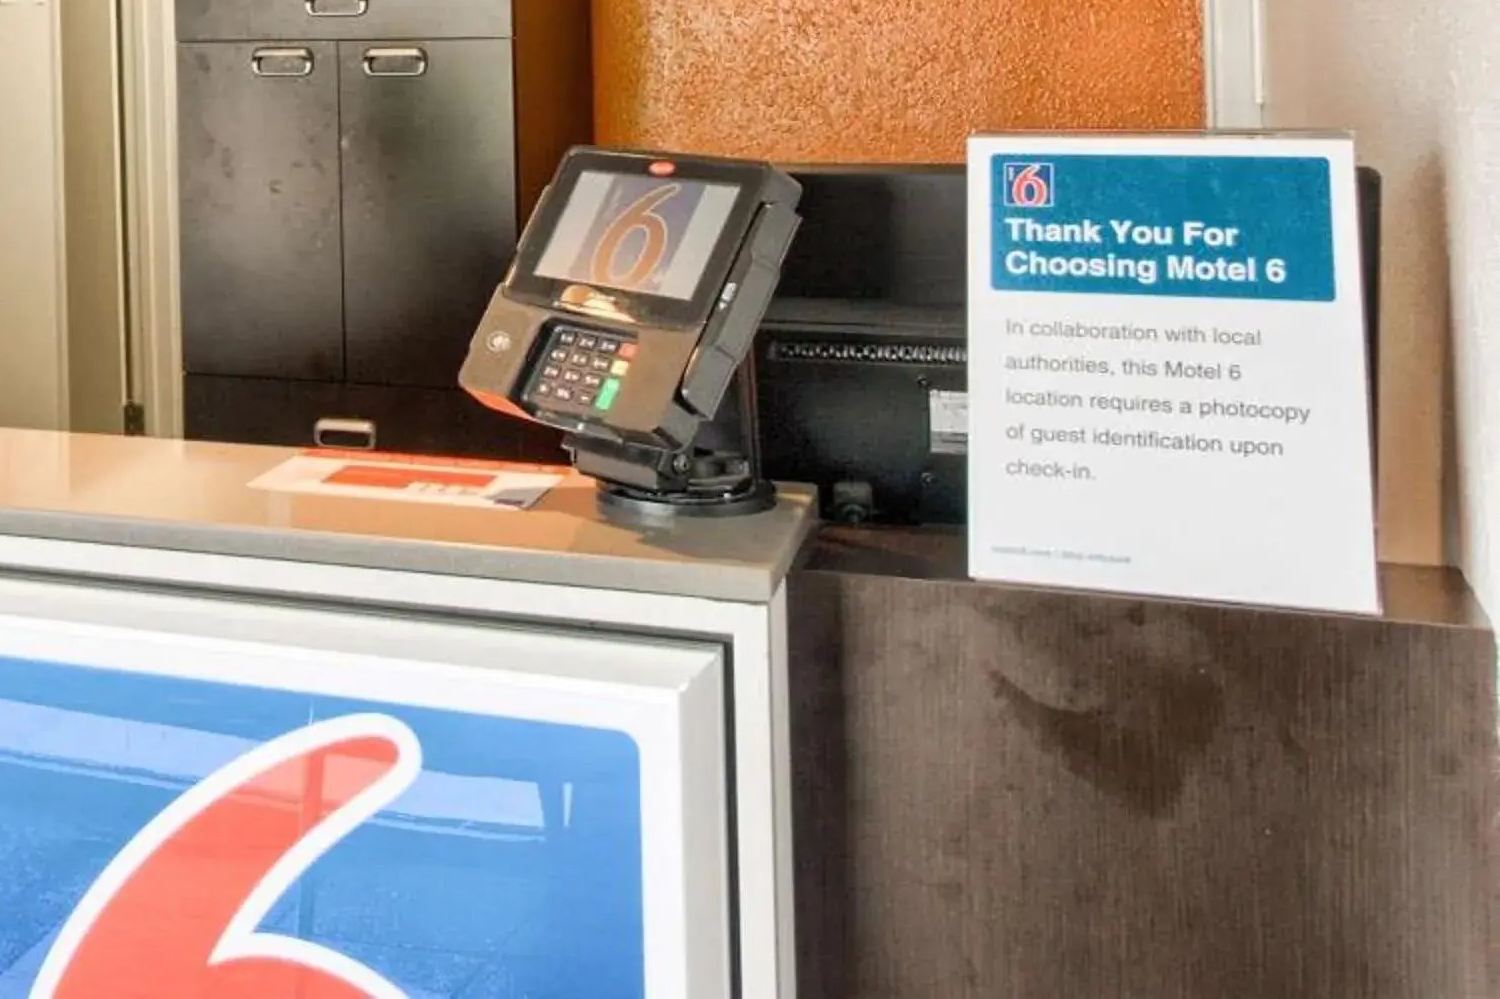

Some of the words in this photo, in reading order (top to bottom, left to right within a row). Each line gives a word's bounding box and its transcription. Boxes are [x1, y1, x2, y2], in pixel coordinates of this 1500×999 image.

[1011, 164, 1048, 207] 6
[590, 183, 682, 288] 6
[1004, 217, 1102, 243] Thank
[1110, 220, 1174, 245] You
[1183, 221, 1239, 247] For
[1005, 250, 1157, 284] Choosing
[1166, 255, 1256, 282] Motel
[1264, 259, 1287, 284] 6
[1006, 319, 1024, 336] In
[1029, 321, 1158, 342] collaboration
[1164, 327, 1206, 344] with
[1213, 327, 1262, 347] local
[1005, 354, 1116, 377] authorities,
[1122, 359, 1158, 377] this
[1165, 360, 1222, 380] Motel
[1228, 364, 1242, 381] 6
[1006, 388, 1083, 409] location
[1089, 394, 1173, 416] requires
[1179, 400, 1193, 415] a
[1199, 400, 1312, 425] photocopy
[1006, 424, 1025, 441] of
[1031, 426, 1086, 447] guest
[1092, 430, 1223, 453] identification
[1229, 438, 1284, 458] upon
[1006, 459, 1098, 482] check-in.
